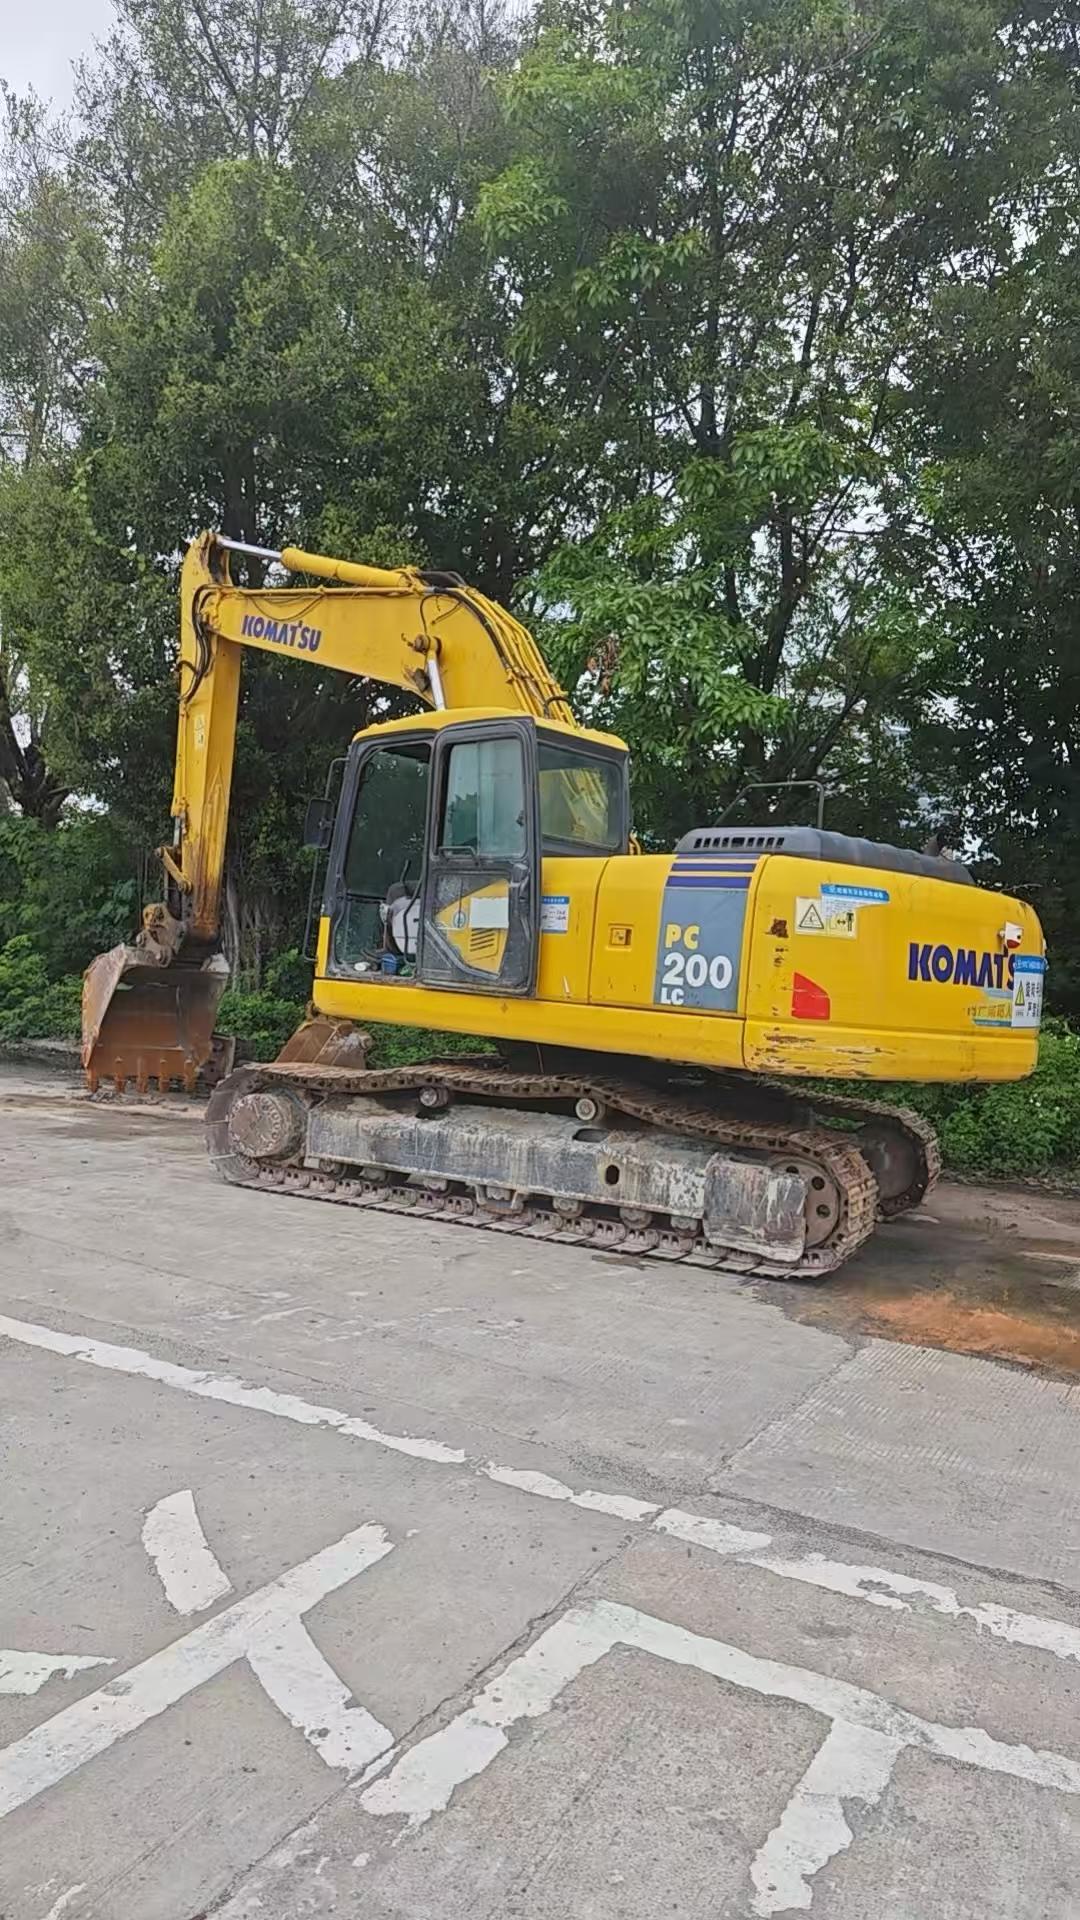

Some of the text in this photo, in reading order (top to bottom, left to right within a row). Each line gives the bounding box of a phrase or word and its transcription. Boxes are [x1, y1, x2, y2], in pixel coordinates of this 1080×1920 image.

[241, 615, 322, 652] KOMATSU
[664, 923, 700, 950] PC
[662, 951, 733, 990] 200
[660, 987, 685, 1006] LC
